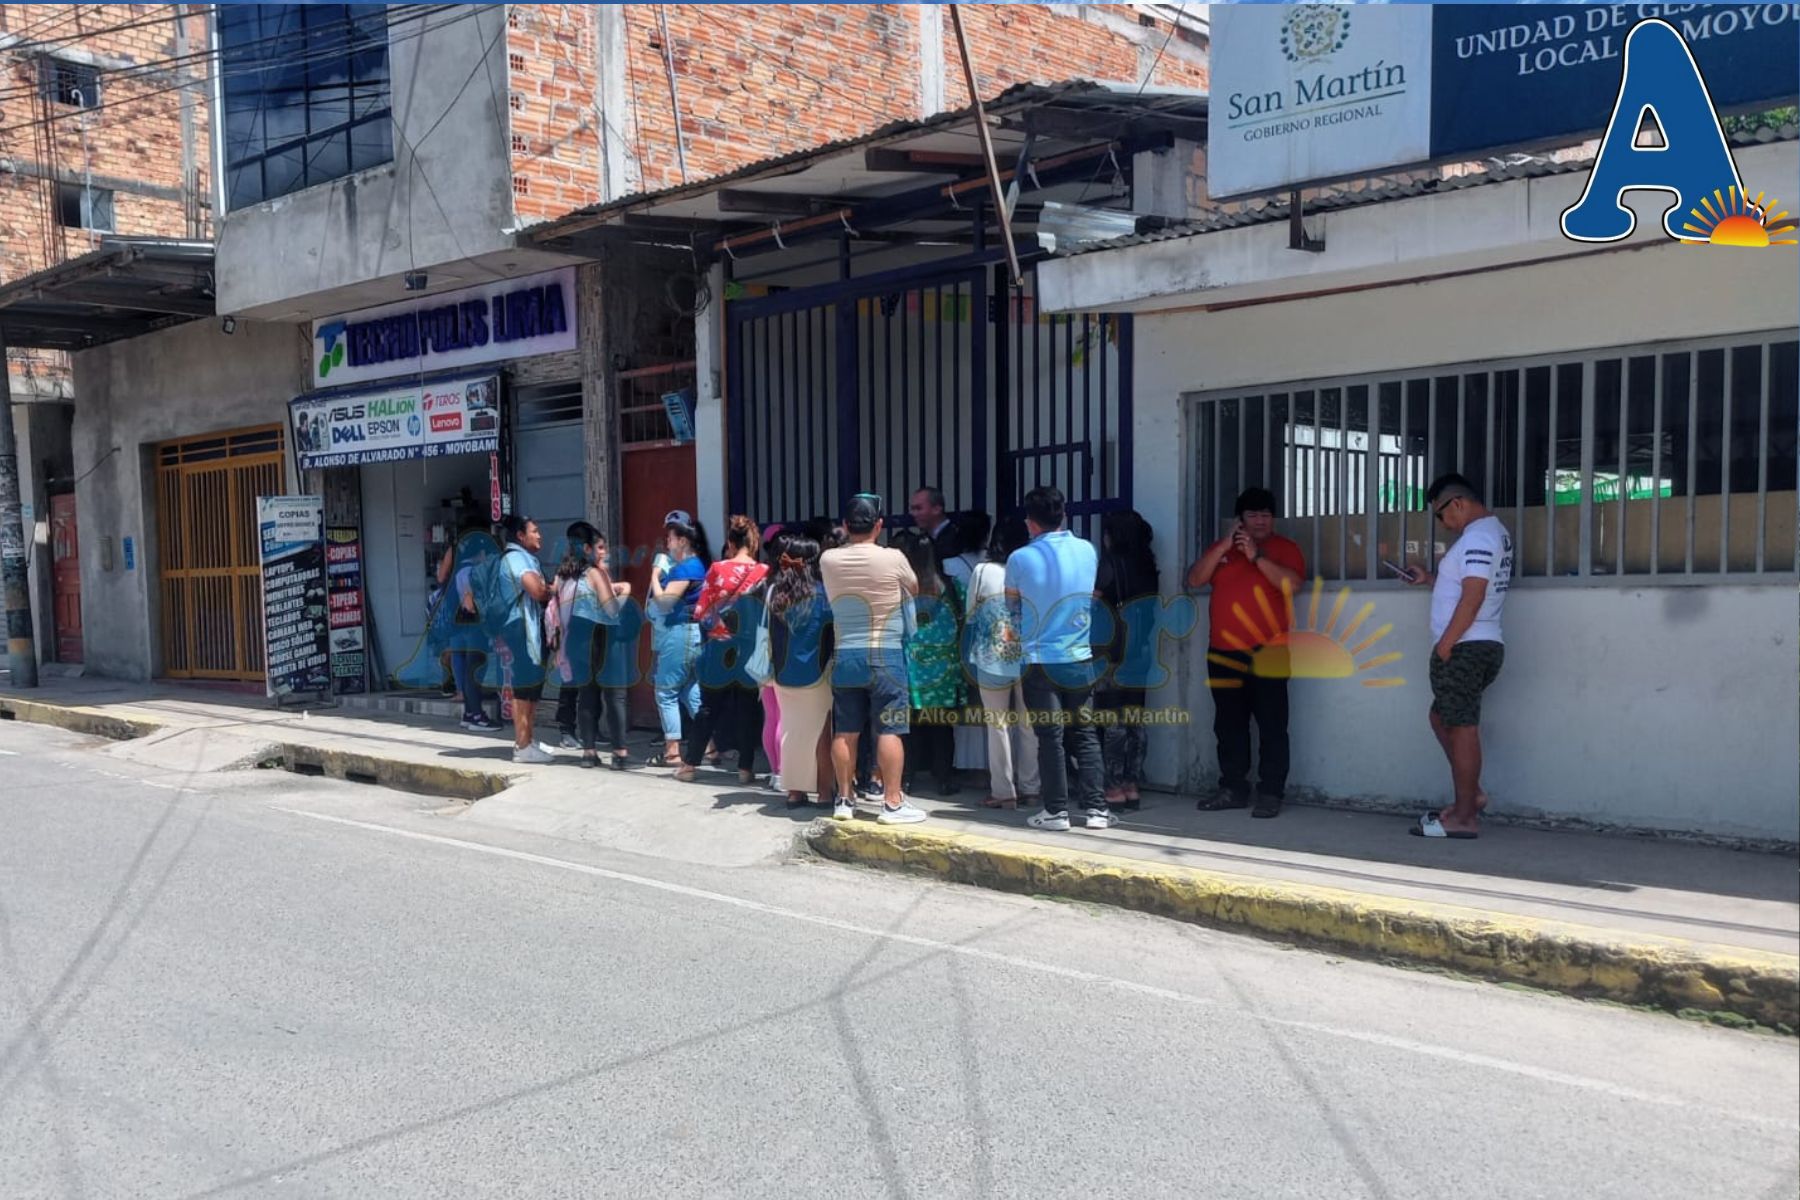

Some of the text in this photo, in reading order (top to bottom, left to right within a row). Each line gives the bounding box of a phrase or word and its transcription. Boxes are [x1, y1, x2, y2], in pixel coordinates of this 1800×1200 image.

[1456, 15, 1575, 59] UNIDAD
[1585, 4, 1627, 32] DE
[1518, 36, 1618, 75] LOCAL
[1228, 60, 1406, 121] San Martín
[1243, 105, 1383, 142] GOBIERNO REGIONAL
[492, 284, 567, 343] LIMA
[435, 393, 461, 407] TEROS
[329, 404, 365, 422] ASUS
[332, 424, 366, 444] DELL
[368, 419, 400, 435] EPSON
[431, 417, 460, 429] Lenovo
[314, 452, 345, 467] ALONSO
[349, 452, 360, 465] DE
[363, 446, 406, 463] ALVARADO
[278, 509, 311, 519] COPIAS
[264, 562, 295, 577] LAPTOPS
[265, 568, 320, 590] COMPUTADORAS
[266, 585, 305, 603] MONITORES
[267, 597, 304, 616] PARLANTES
[267, 610, 301, 628] TECLADOS
[298, 620, 313, 633] WEB
